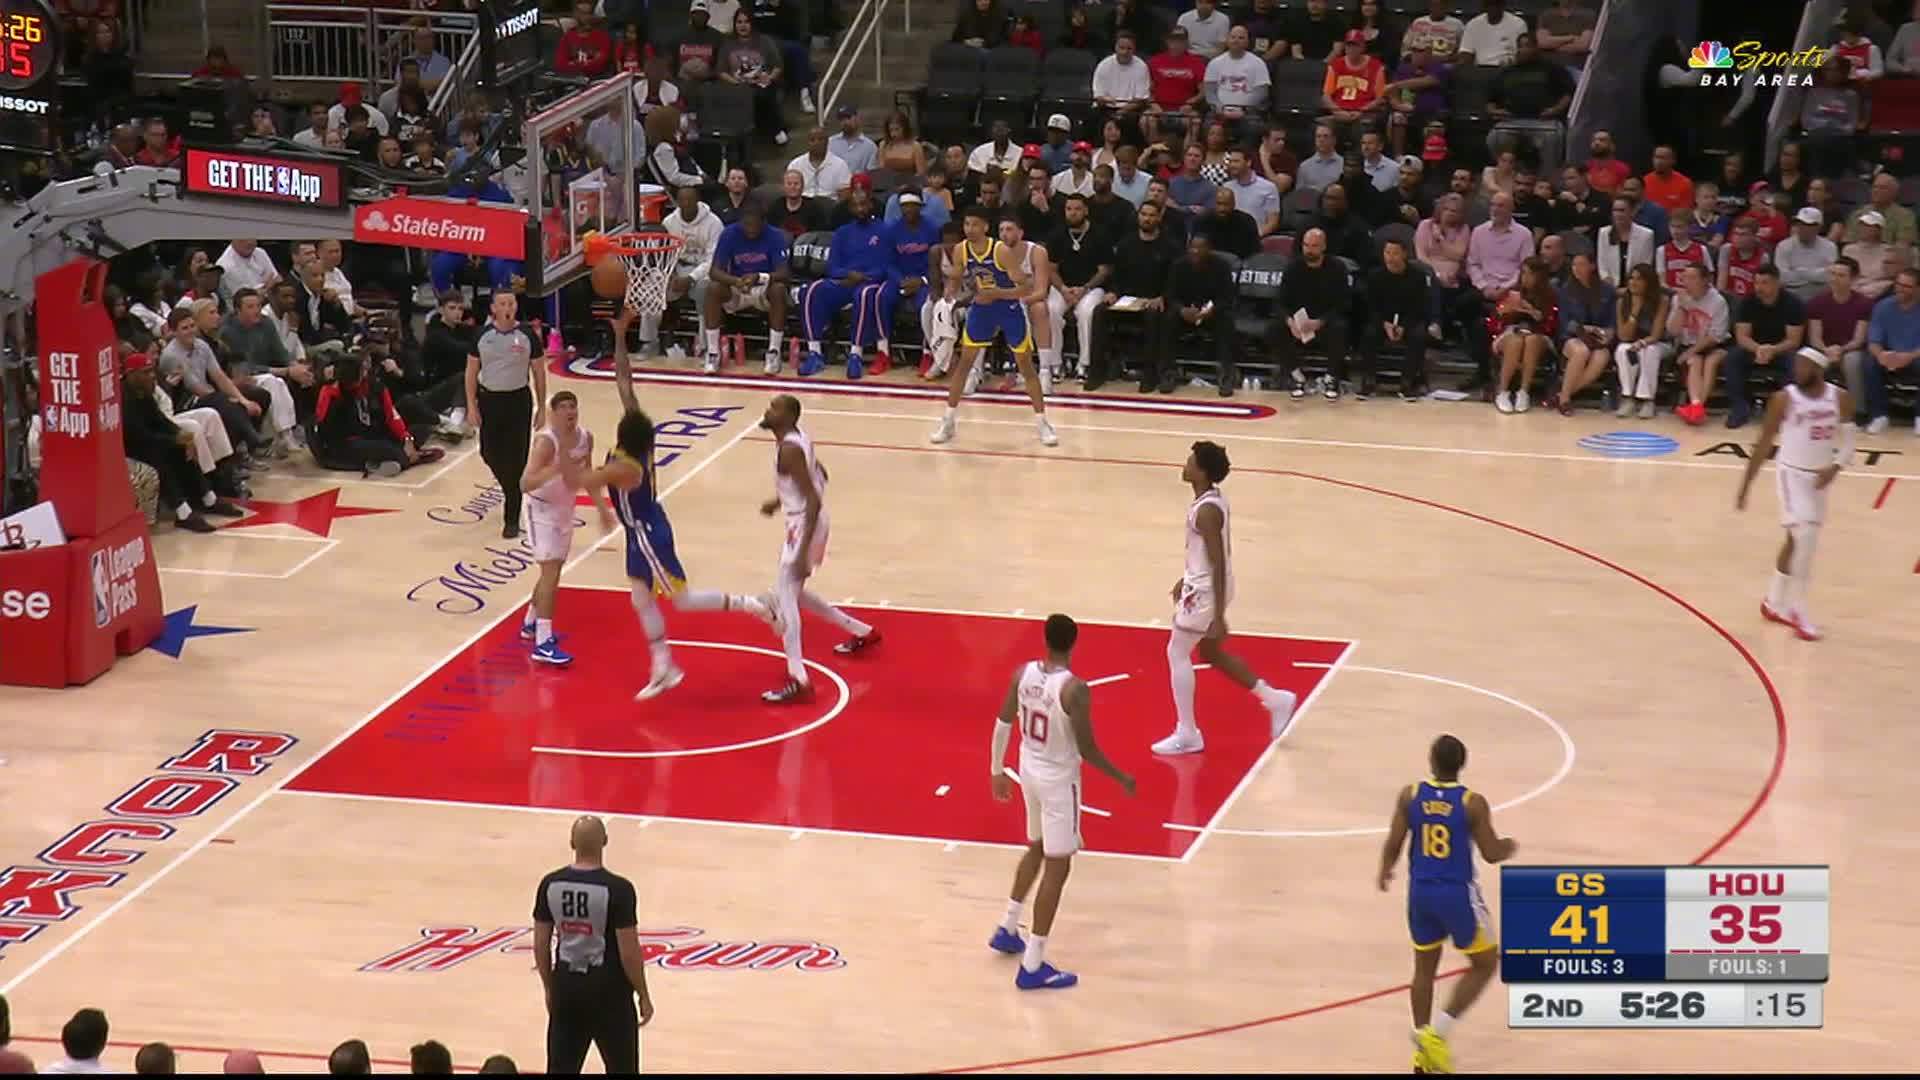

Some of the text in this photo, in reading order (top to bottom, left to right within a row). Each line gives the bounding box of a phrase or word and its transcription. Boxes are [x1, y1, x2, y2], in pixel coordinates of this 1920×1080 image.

[506, 8, 538, 36] TISSOT
[208, 159, 320, 203] GET THE App
[49, 352, 79, 378] GET
[51, 378, 82, 405] THE
[61, 406, 90, 438] App
[108, 536, 145, 580] League
[0, 589, 51, 619] se
[111, 578, 137, 619] Pass
[1022, 703, 1048, 744] 10
[1422, 823, 1451, 859] 18
[562, 890, 589, 918] 28
